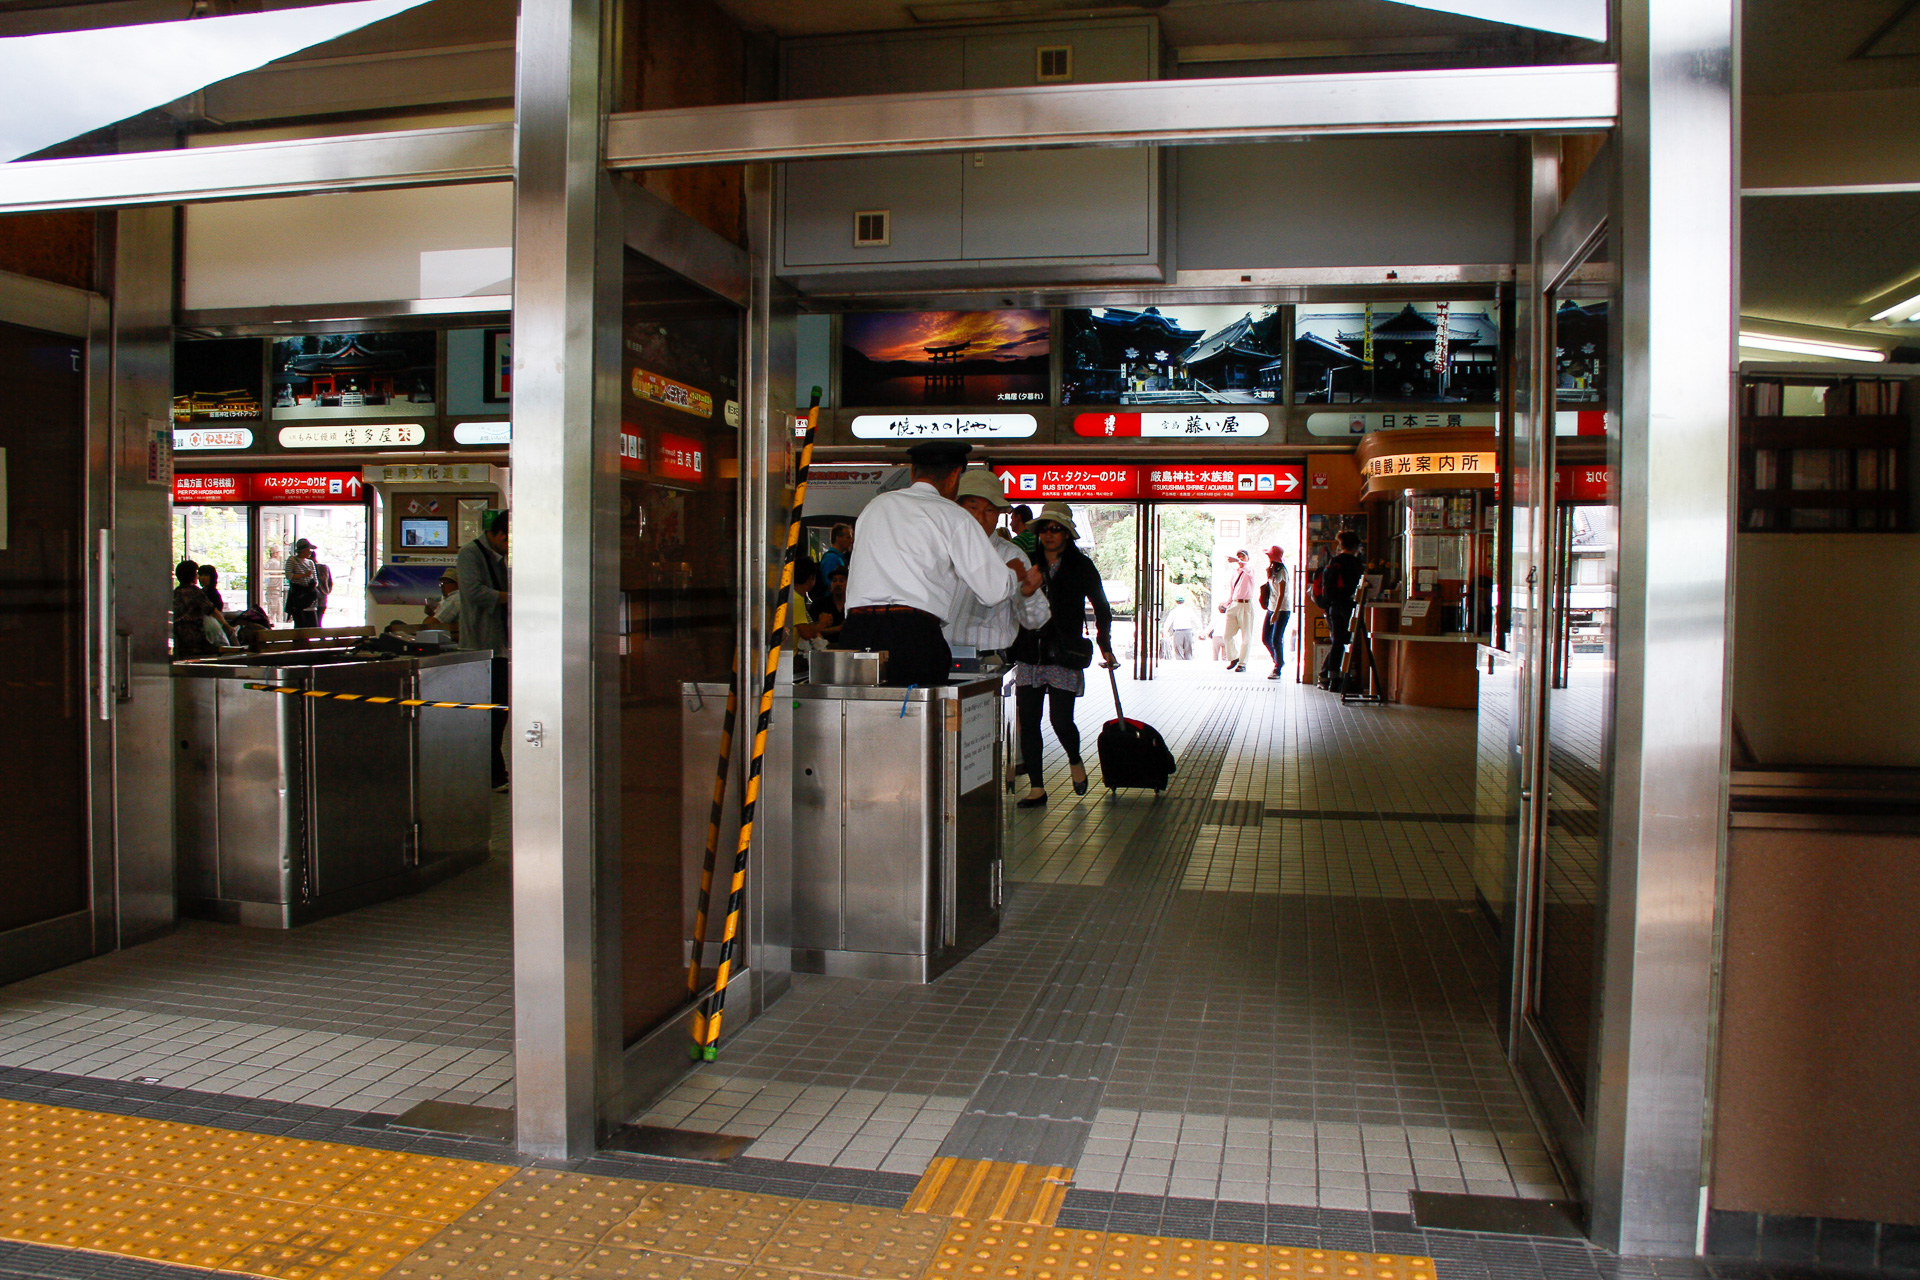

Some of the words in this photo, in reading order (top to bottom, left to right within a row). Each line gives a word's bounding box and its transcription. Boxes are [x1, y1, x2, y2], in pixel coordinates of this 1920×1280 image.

[1382, 414, 1462, 428] 日本三景
[264, 477, 327, 487] バス・タクシーのりば
[1042, 471, 1127, 482] バス・タクシーのりば
[1150, 471, 1234, 482] 厳島神社・水族館
